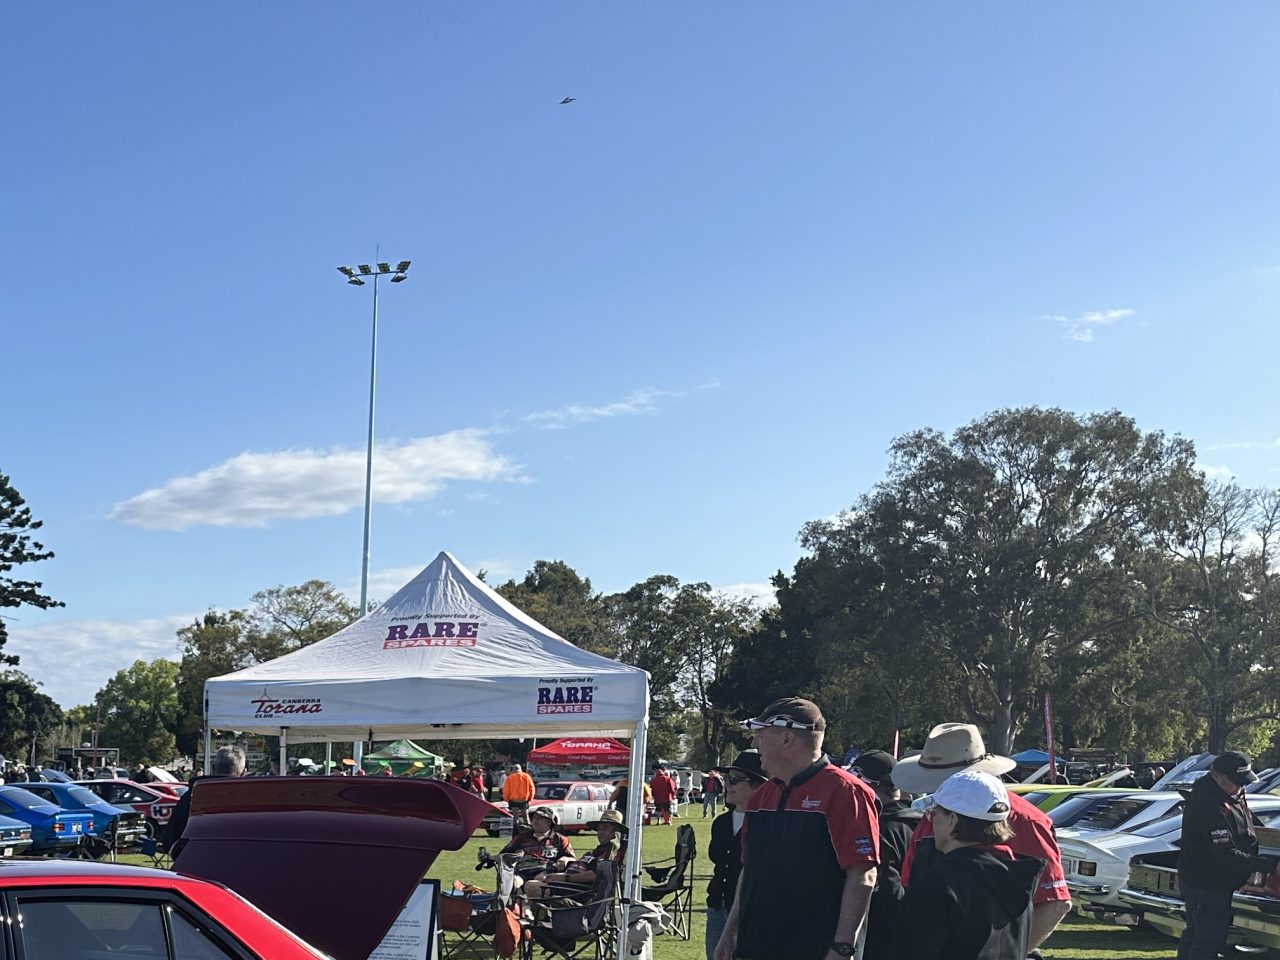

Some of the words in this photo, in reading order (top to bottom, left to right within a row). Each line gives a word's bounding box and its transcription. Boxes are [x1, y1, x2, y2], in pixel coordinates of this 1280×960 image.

[385, 622, 479, 640] RARE
[384, 639, 476, 649] SPARES
[537, 686, 593, 704] RARE
[251, 699, 323, 714] Torana
[538, 705, 591, 713] SPARES
[577, 808, 583, 820] 6
